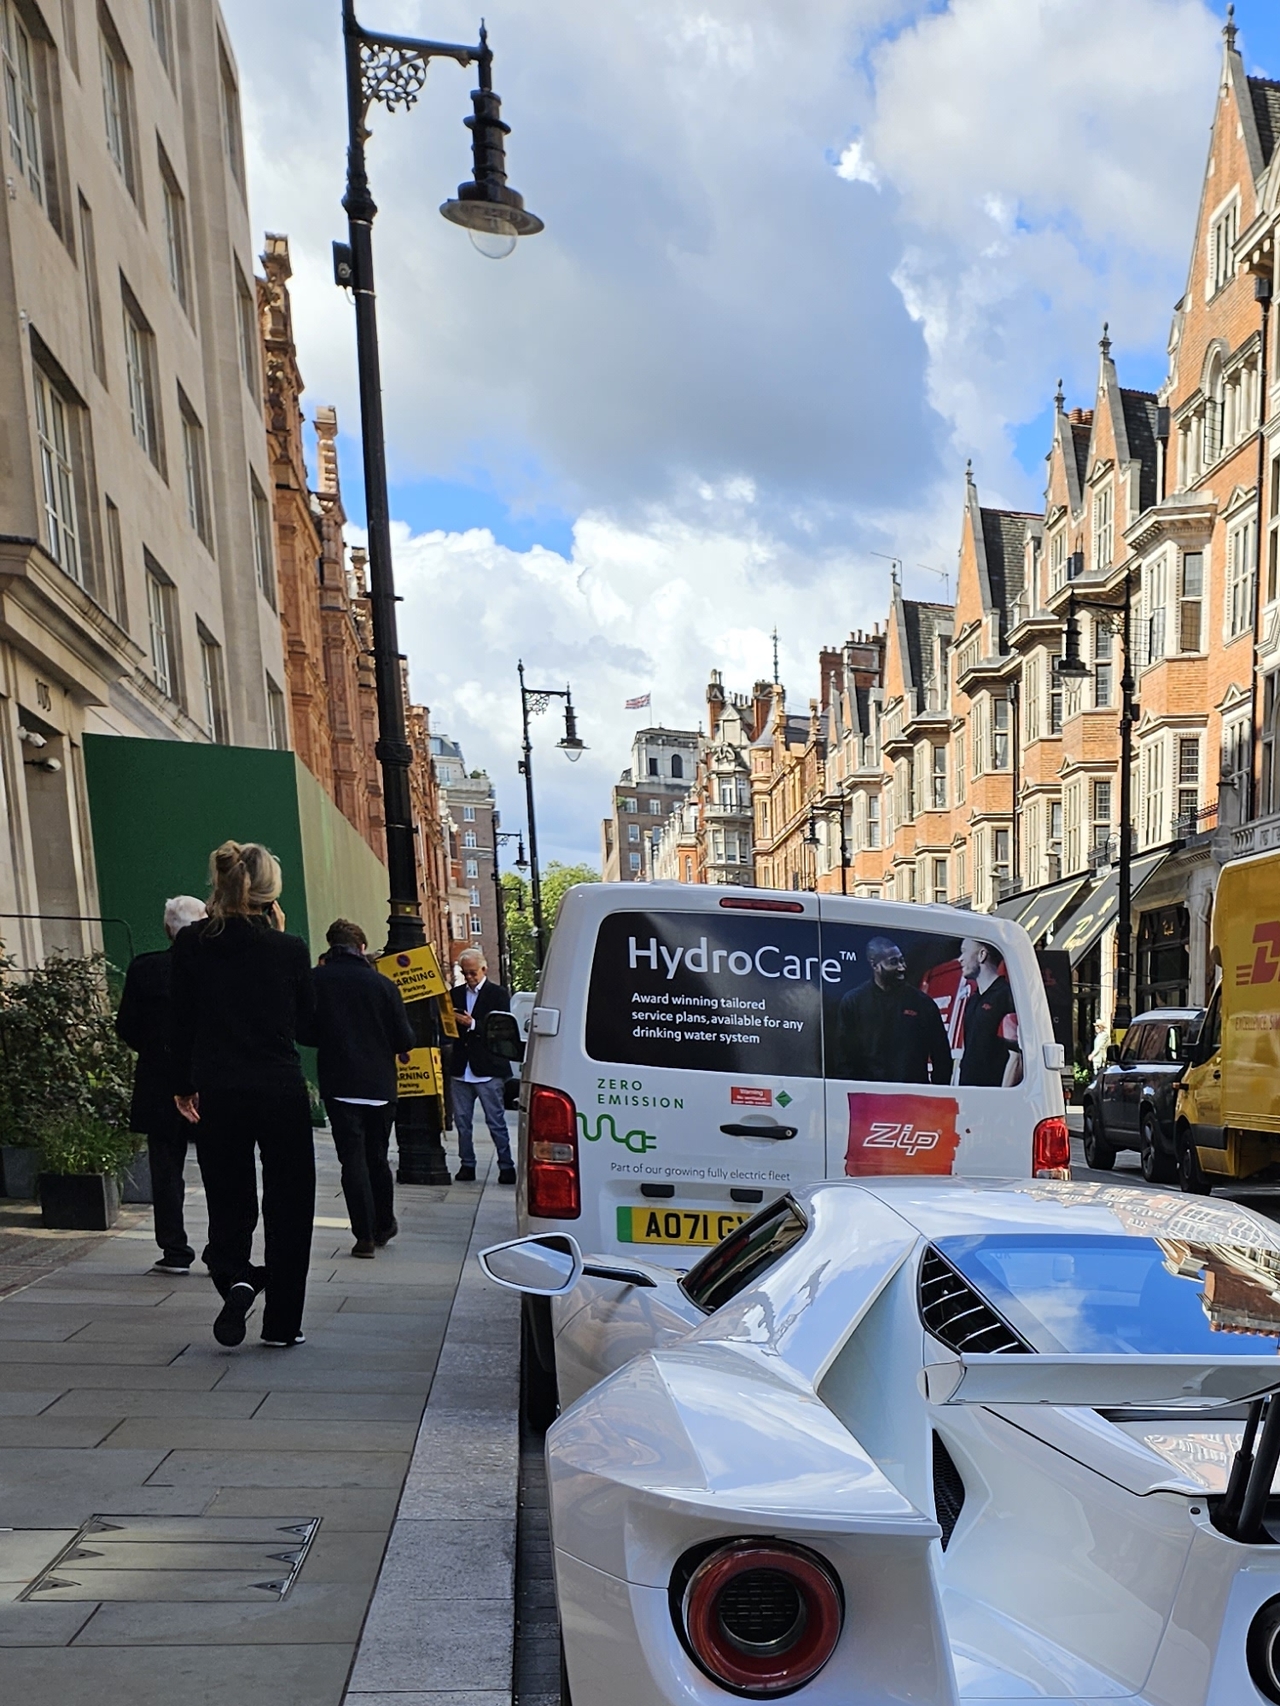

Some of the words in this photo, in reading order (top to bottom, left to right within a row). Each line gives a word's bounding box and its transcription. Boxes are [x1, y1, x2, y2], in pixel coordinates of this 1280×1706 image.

[395, 970, 436, 987] ARNING
[631, 992, 669, 1005] Award
[672, 994, 718, 1010] winning
[720, 997, 766, 1010] tailored
[631, 1011, 673, 1022] service
[711, 1014, 762, 1027] available
[763, 1015, 781, 1028] for
[782, 1019, 804, 1032] any
[632, 1026, 682, 1042] drinking
[684, 1030, 717, 1041] water
[719, 1032, 760, 1044] system
[597, 1078, 643, 1091] ZERO
[597, 1094, 684, 1109] EMISSION
[610, 1162, 630, 1173] Part
[632, 1163, 644, 1173] of
[645, 1166, 663, 1175] our
[664, 1166, 705, 1179] growing
[707, 1168, 728, 1180] fully
[730, 1169, 767, 1181] electric
[768, 1170, 791, 1181] fleet
[645, 1211, 709, 1240] AO71
